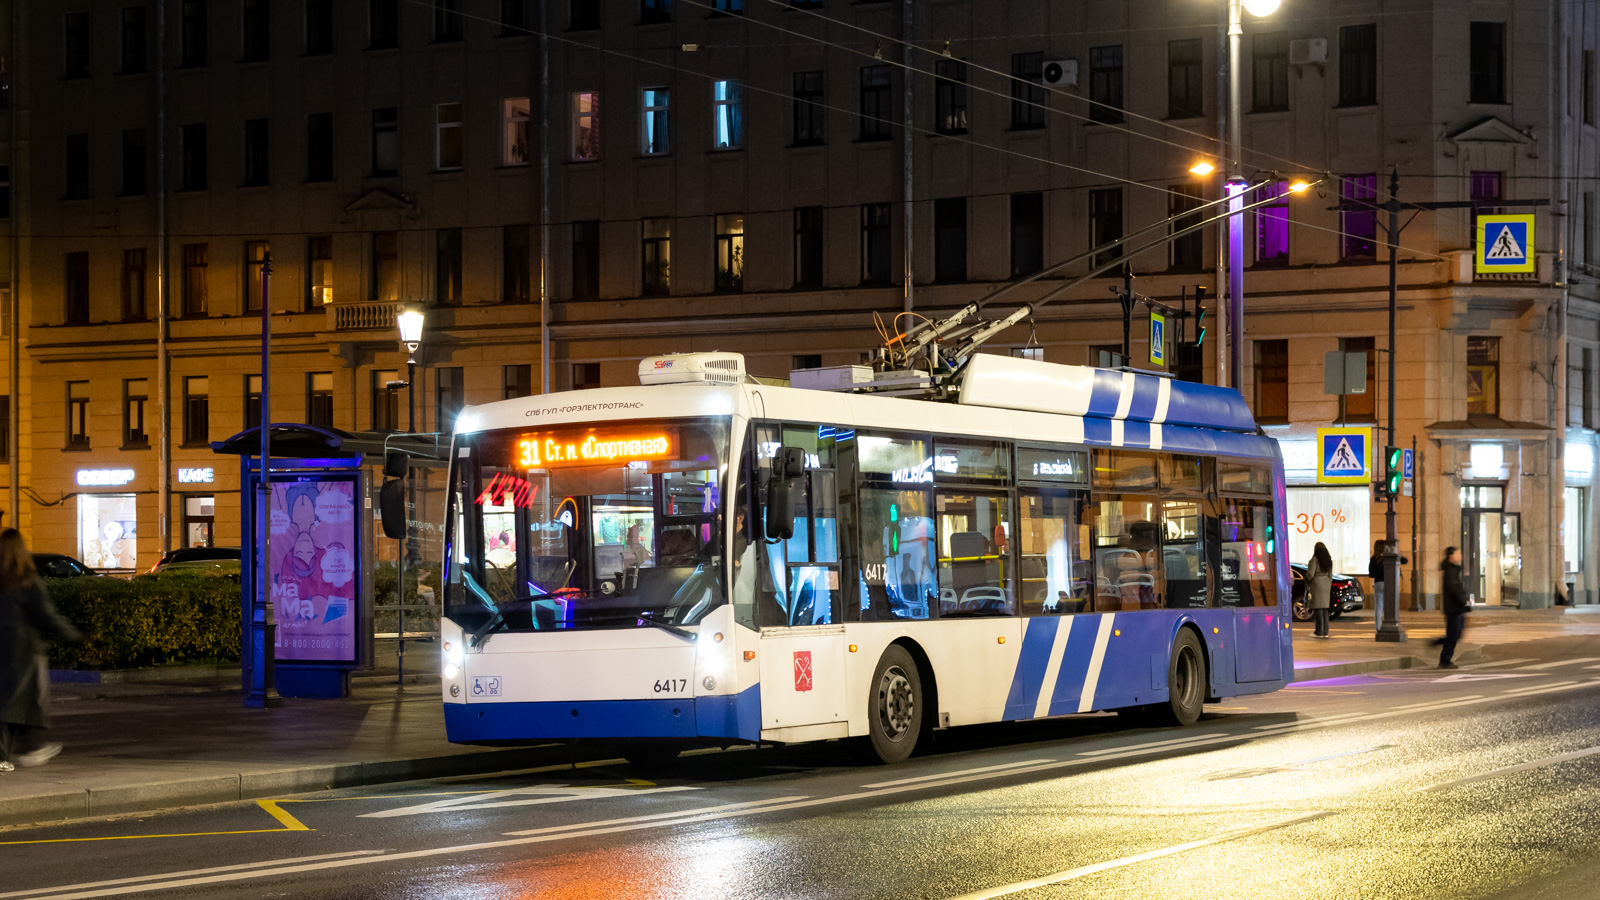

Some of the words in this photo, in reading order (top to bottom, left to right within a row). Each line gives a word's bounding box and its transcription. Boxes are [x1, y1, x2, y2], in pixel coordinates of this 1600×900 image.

[542, 407, 558, 416] ГУП
[559, 402, 644, 414] «ГОРЭЛЕКТРОТРАНС»
[519, 440, 541, 464] 31
[545, 438, 563, 460] Ст.
[567, 444, 578, 459] м.
[581, 437, 668, 460] «Спортивная»
[178, 468, 213, 483] КАФЕ
[1287, 513, 1325, 534] -30
[1331, 508, 1346, 524] %
[865, 563, 887, 581] 6417
[653, 679, 687, 692] 6417
